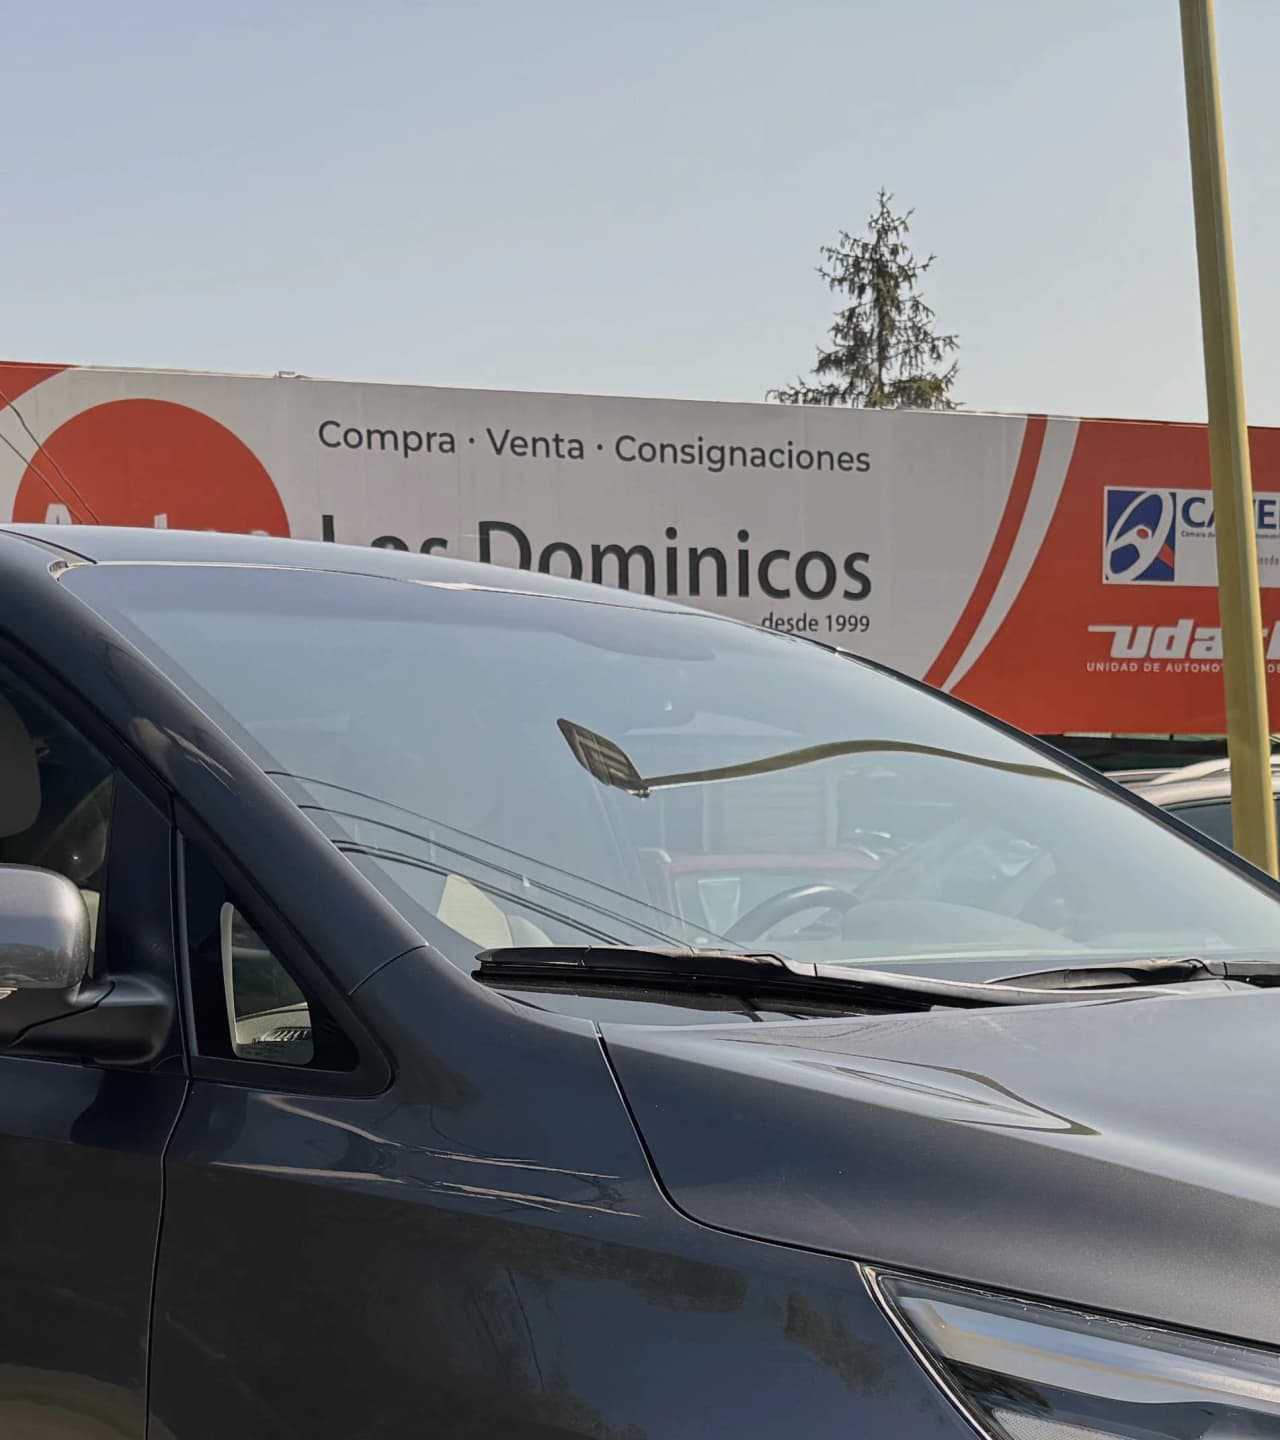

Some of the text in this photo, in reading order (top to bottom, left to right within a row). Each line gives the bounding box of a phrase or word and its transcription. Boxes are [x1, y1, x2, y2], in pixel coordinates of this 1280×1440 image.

[318, 420, 871, 473] Compra Venta Consignaciones
[478, 521, 872, 602] Dominicos
[761, 611, 870, 633] desde 1999
[1087, 662, 1138, 672] UNIDAD
[1144, 663, 1160, 672] DE
